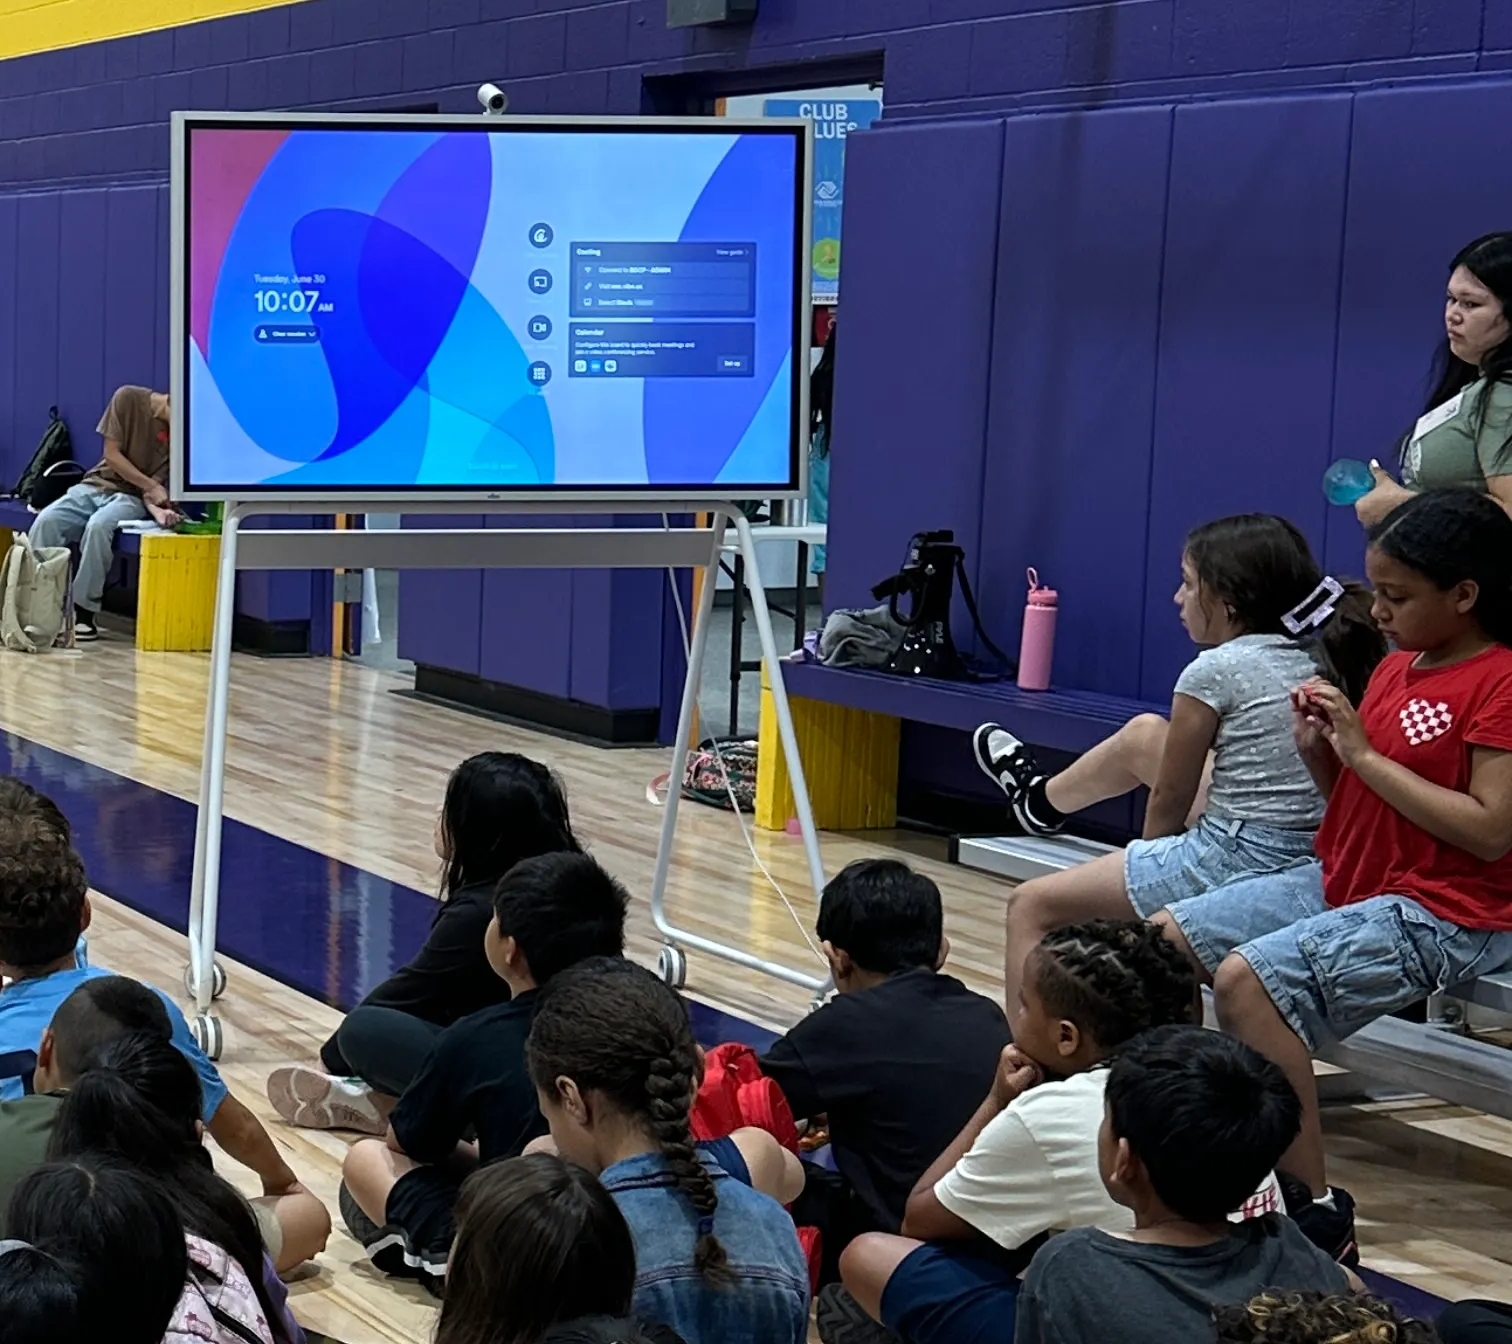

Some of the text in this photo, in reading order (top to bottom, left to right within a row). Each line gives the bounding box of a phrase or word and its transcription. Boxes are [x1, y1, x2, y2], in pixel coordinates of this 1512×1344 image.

[799, 103, 848, 120] CLUB
[254, 273, 326, 285] Tuesday, June 30
[254, 290, 334, 312] 10:07 AM
